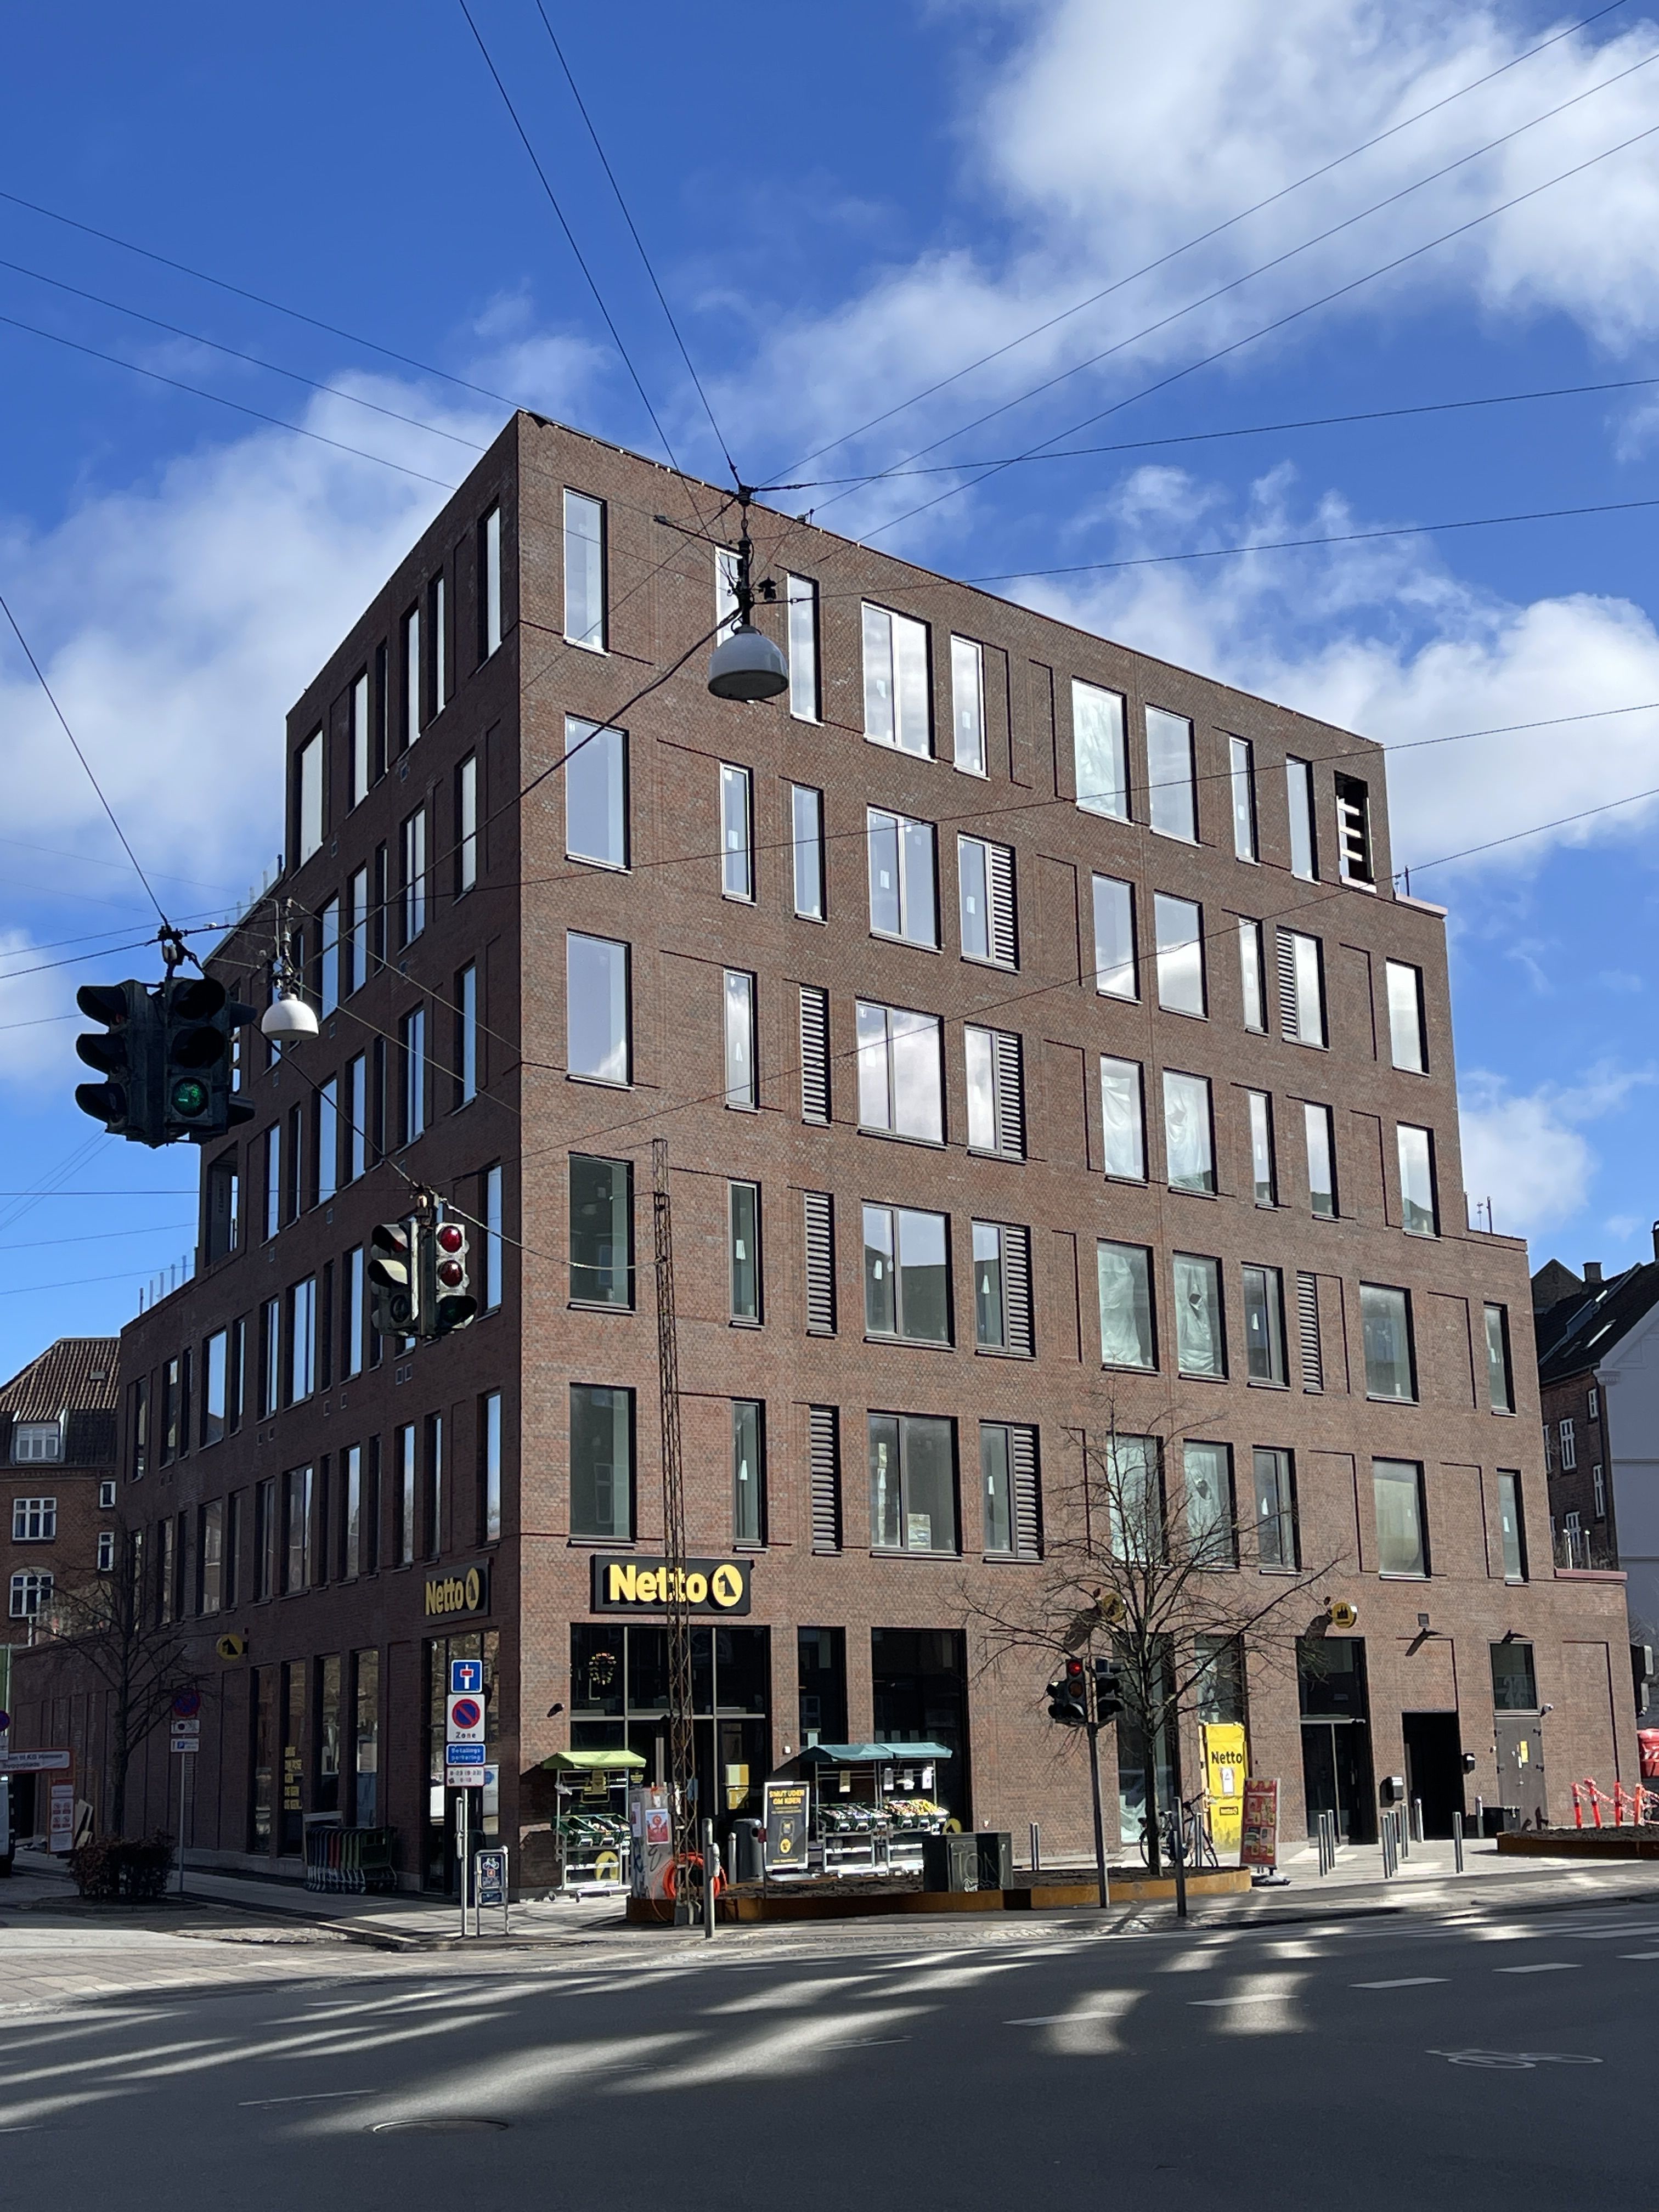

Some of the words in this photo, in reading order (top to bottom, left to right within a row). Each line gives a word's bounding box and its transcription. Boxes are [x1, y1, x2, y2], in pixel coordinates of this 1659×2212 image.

[426, 1577, 464, 1615] Netto
[610, 1564, 708, 1602] Netto
[1211, 1751, 1243, 1764] Netto
